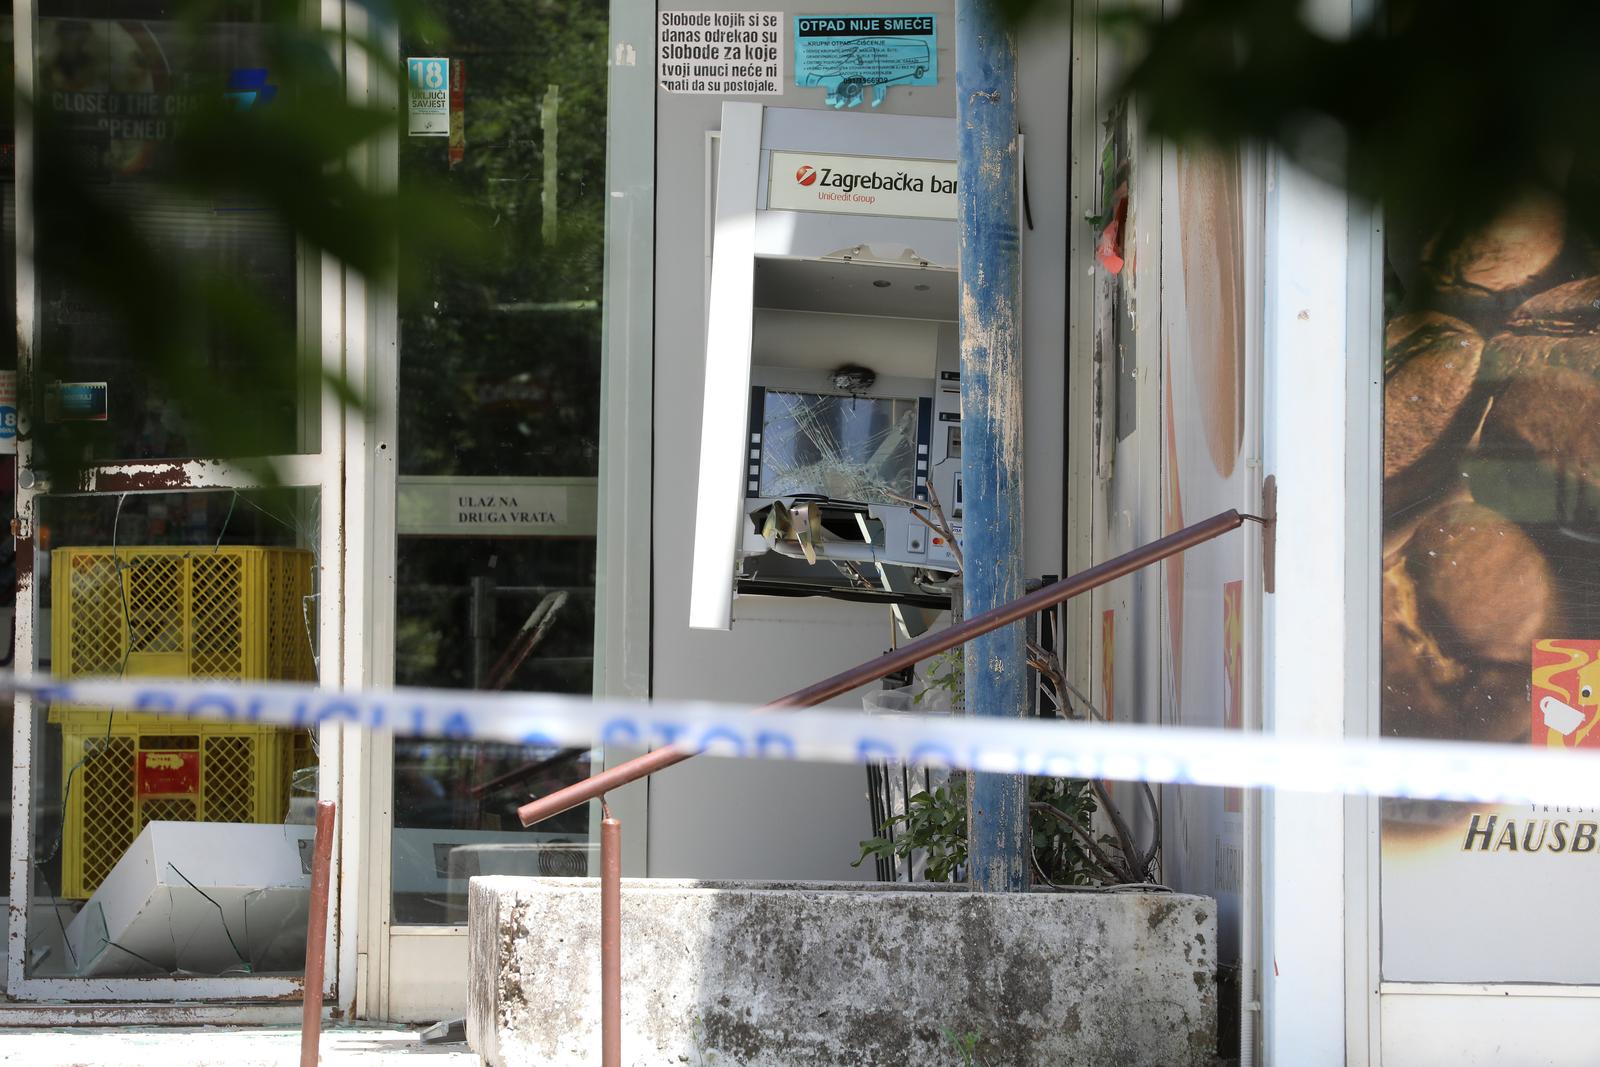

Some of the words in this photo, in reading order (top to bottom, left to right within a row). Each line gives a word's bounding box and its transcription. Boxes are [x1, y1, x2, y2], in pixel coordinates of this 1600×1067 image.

[662, 13, 711, 26] Slobode
[714, 13, 744, 28] kojih
[748, 13, 759, 26] si
[763, 16, 777, 26] se
[800, 20, 846, 31] OTPAD
[850, 20, 880, 31] NIJE
[884, 16, 931, 30] SMEĆE
[662, 29, 700, 42] danas
[704, 29, 758, 43] odrekao
[762, 31, 777, 43] su
[662, 44, 719, 60] slobode
[724, 46, 741, 60] za
[745, 44, 777, 62] koje
[412, 61, 443, 89] 18
[662, 63, 690, 78] tvoji
[694, 64, 728, 77] unuci
[732, 63, 762, 77] neće
[766, 64, 777, 77] ni
[692, 79, 705, 91] da
[708, 81, 720, 92] su
[724, 80, 777, 93] postojale.
[412, 100, 446, 108] SAVJEST
[820, 168, 924, 193] Zagrebačka
[818, 192, 852, 202] UniCredit
[852, 194, 876, 204] Group
[458, 497, 495, 507] ULAZ
[500, 497, 518, 507] NA
[458, 512, 506, 523] DRUGA
[510, 512, 556, 523] VRATA
